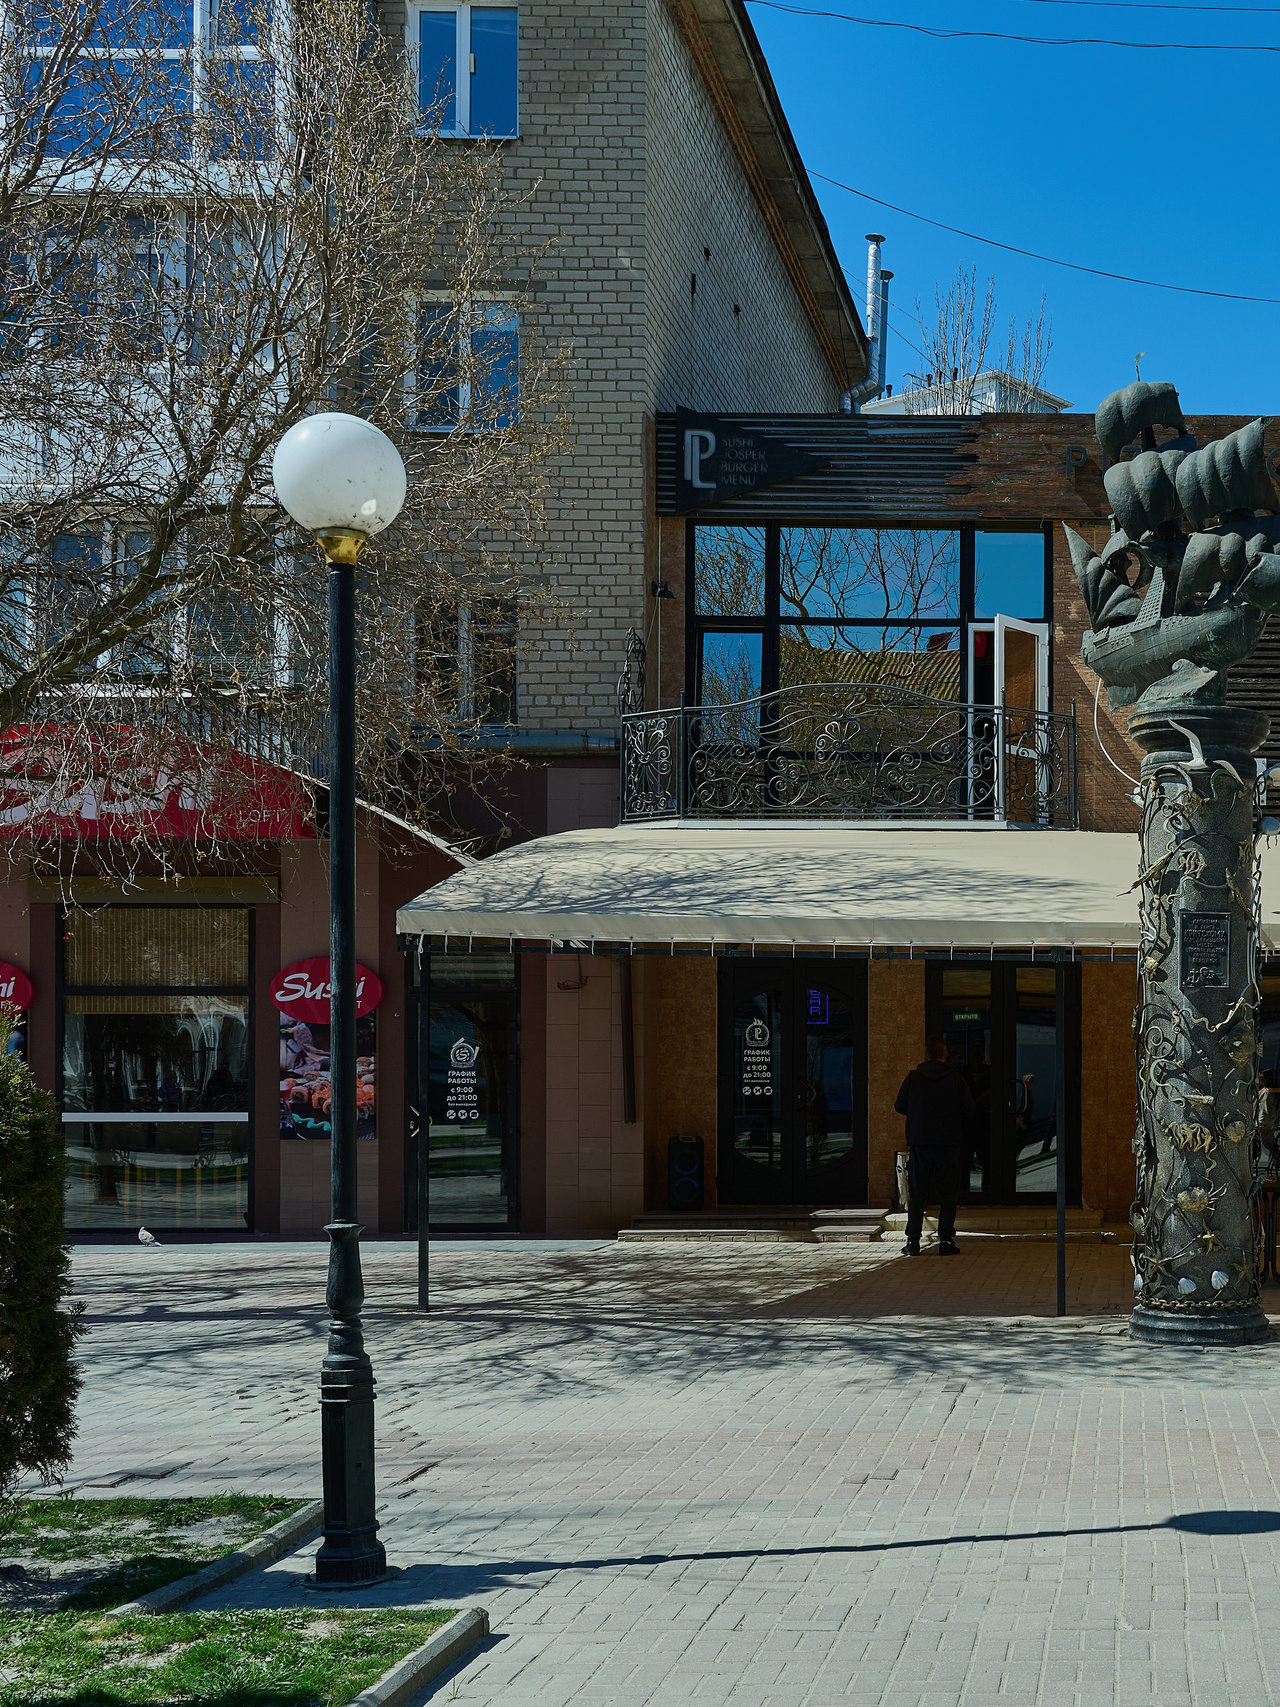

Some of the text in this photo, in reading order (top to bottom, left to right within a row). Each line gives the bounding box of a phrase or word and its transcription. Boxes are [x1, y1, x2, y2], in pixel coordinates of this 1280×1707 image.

[722, 439, 754, 447] SUSHI
[723, 449, 766, 460] JOSPER
[722, 462, 769, 473] BURGER
[721, 474, 756, 486] MENU
[239, 809, 285, 823] LOFT
[275, 971, 366, 1002] Susi
